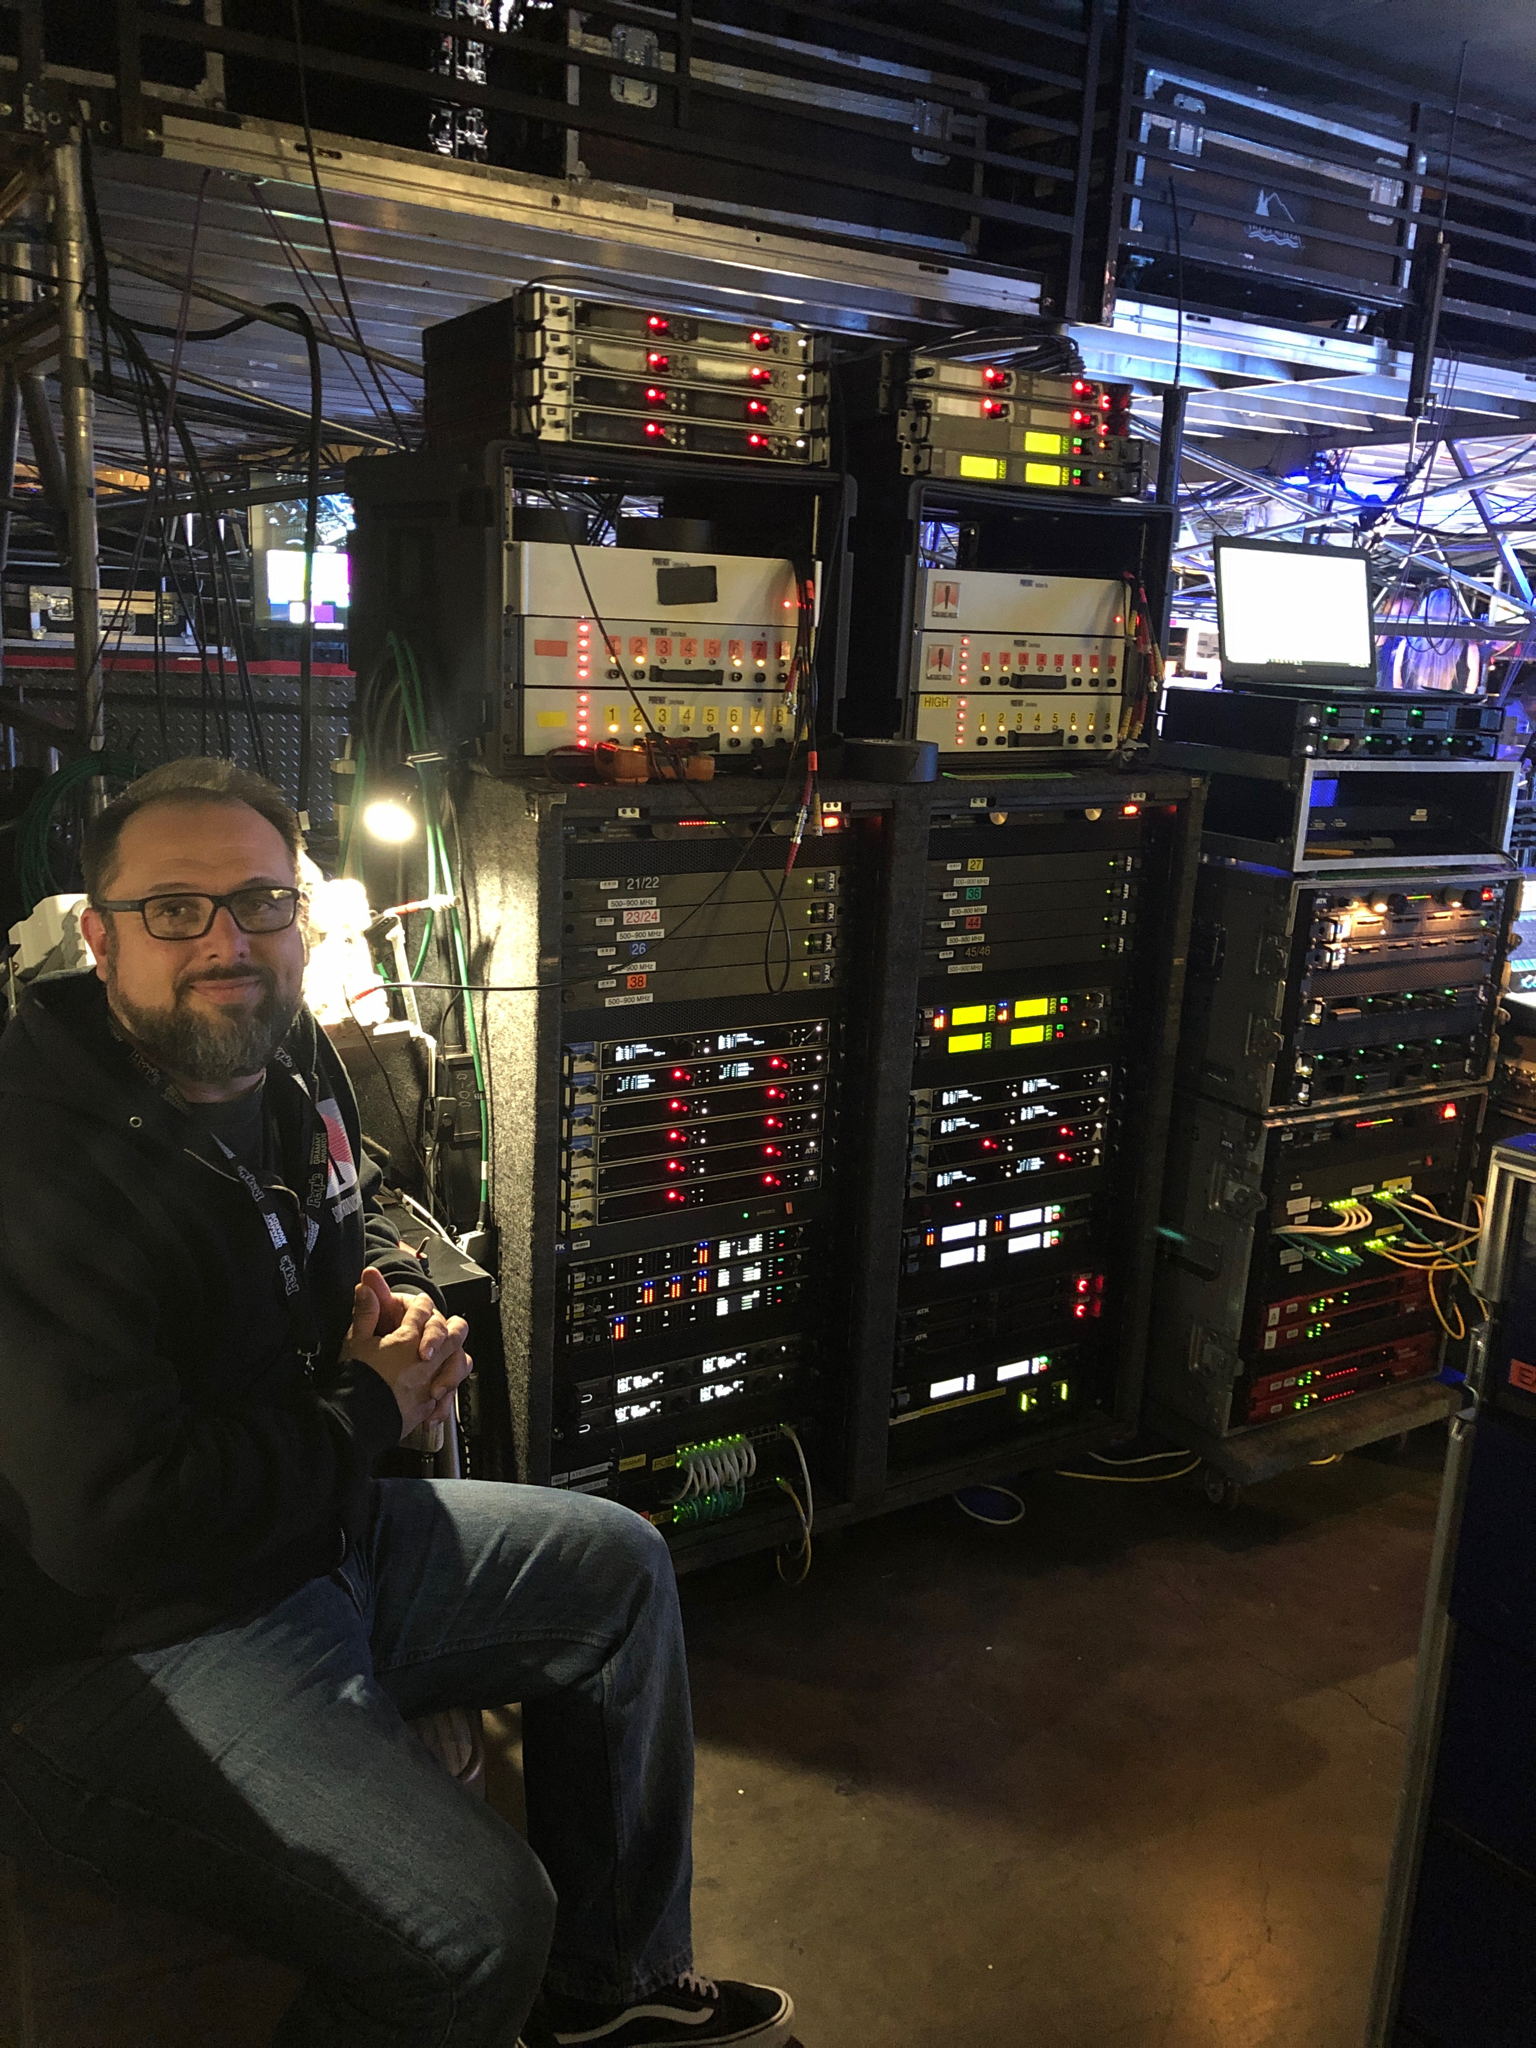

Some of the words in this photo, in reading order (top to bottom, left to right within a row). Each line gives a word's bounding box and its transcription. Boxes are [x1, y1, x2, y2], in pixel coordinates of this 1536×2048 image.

[634, 639, 643, 654] 2
[659, 640, 667, 654] 3
[684, 640, 693, 653] 4
[709, 641, 717, 655] 5
[756, 642, 764, 655] 7
[924, 696, 949, 707] HIGH
[609, 708, 615, 721] 1
[633, 708, 642, 721] 2
[659, 709, 667, 721] 3
[683, 709, 691, 721] 4
[707, 709, 715, 722] 5
[730, 710, 738, 722] 6
[755, 710, 763, 722] 7
[969, 859, 982, 870] 27
[627, 877, 660, 890] 21/22
[626, 911, 658, 924] 23/24
[827, 903, 835, 920] ATK
[631, 943, 646, 955] 26
[630, 976, 644, 988] 38
[306, 1173, 324, 1208] People
[280, 1254, 300, 1296] People
